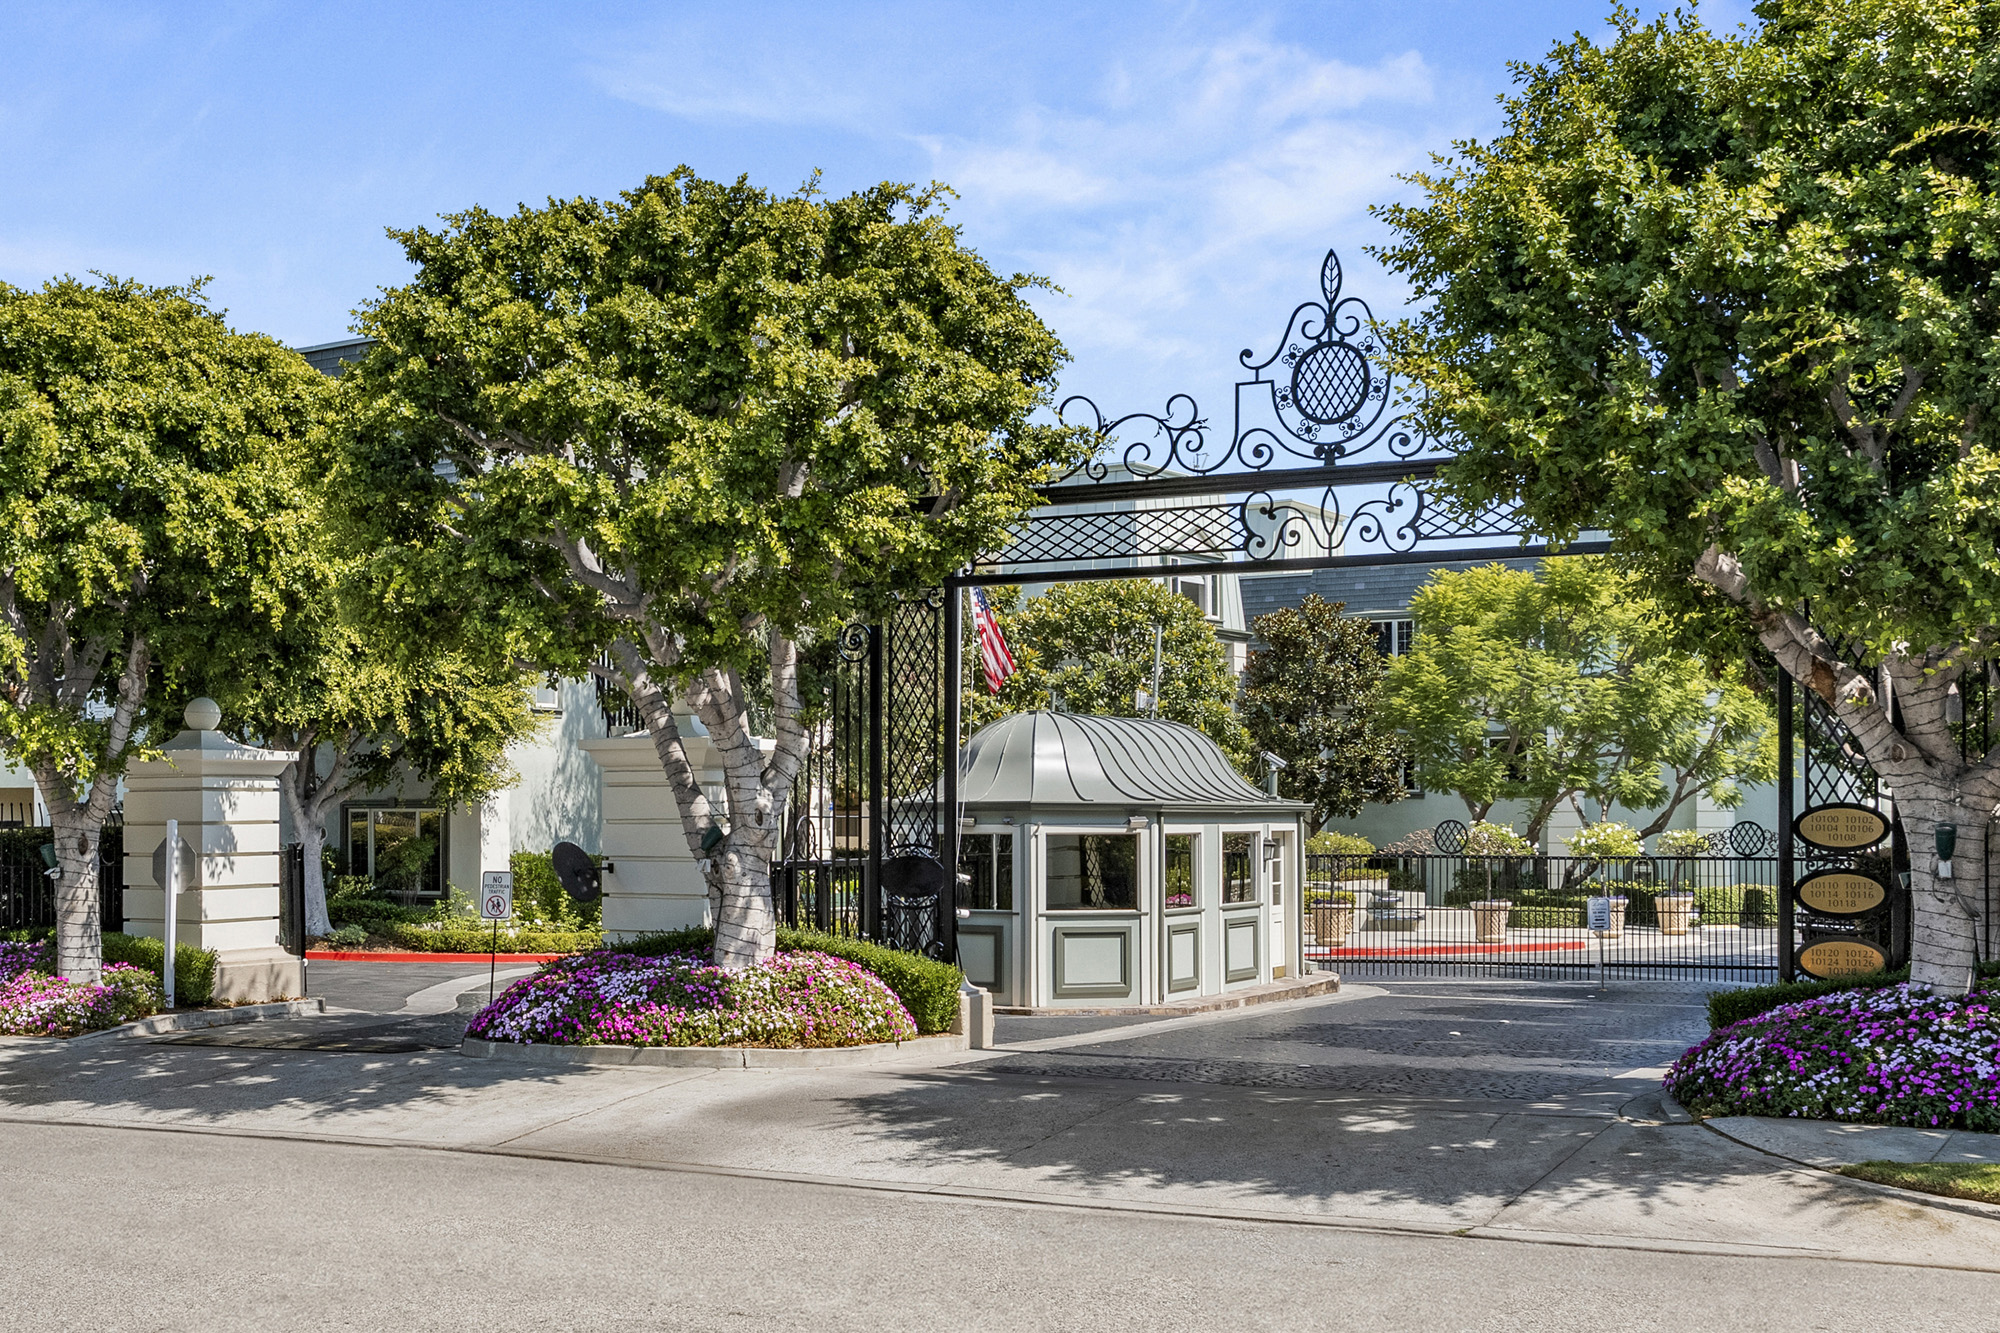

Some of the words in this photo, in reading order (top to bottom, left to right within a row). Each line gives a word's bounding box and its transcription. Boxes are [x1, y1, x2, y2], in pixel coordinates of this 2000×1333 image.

[1810, 815, 1839, 823] 10100
[1845, 816, 1874, 824] 10102
[1810, 824, 1838, 832] 10104
[1845, 825, 1874, 833] 10106
[1828, 833, 1856, 841] 10108
[1810, 881, 1838, 890] 10110
[1845, 882, 1874, 890] 10112
[1810, 890, 1838, 898] 10114
[1845, 891, 1874, 899] 10116
[1810, 949, 1839, 957] 10120
[1845, 950, 1874, 958] 10122
[1810, 958, 1839, 966] 10124
[1845, 959, 1874, 967] 10126
